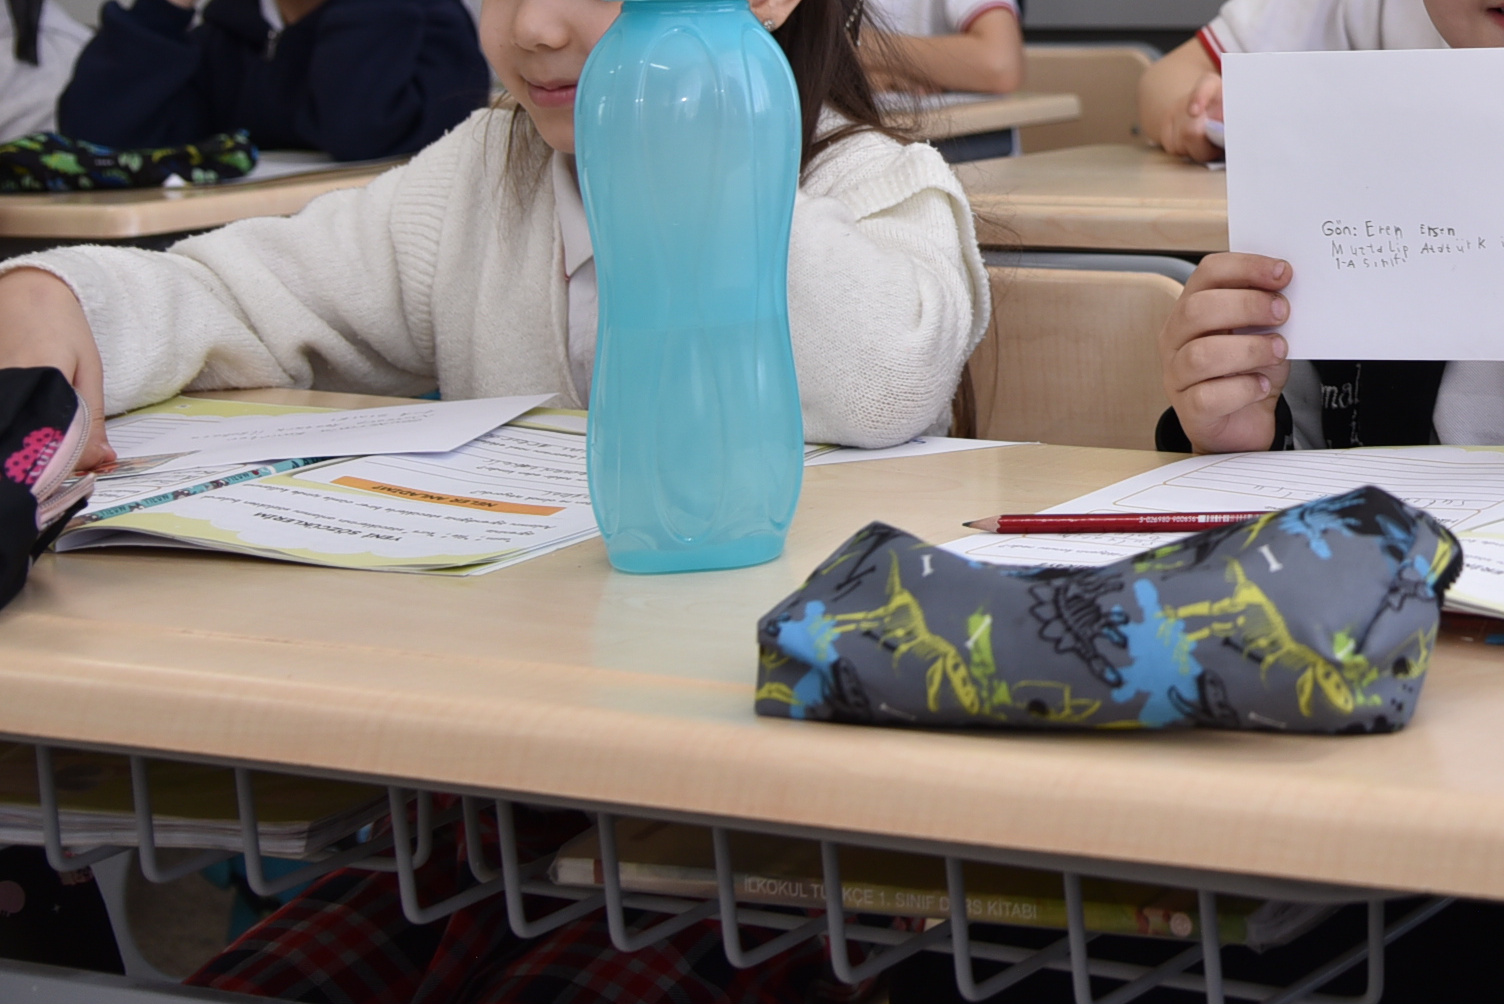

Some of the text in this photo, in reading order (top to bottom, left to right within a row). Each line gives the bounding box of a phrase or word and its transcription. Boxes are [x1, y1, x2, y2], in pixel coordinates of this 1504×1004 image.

[1321, 220, 1357, 236] Gön:
[1365, 220, 1403, 238] Eren
[371, 485, 498, 507] NELER ANLADIM?
[253, 512, 361, 536] SÖZCÜKLERİM
[362, 533, 403, 542] YENİ
[744, 875, 1038, 919] İLKOKUL TKÇE 1. SINIF DRS KİTABI
